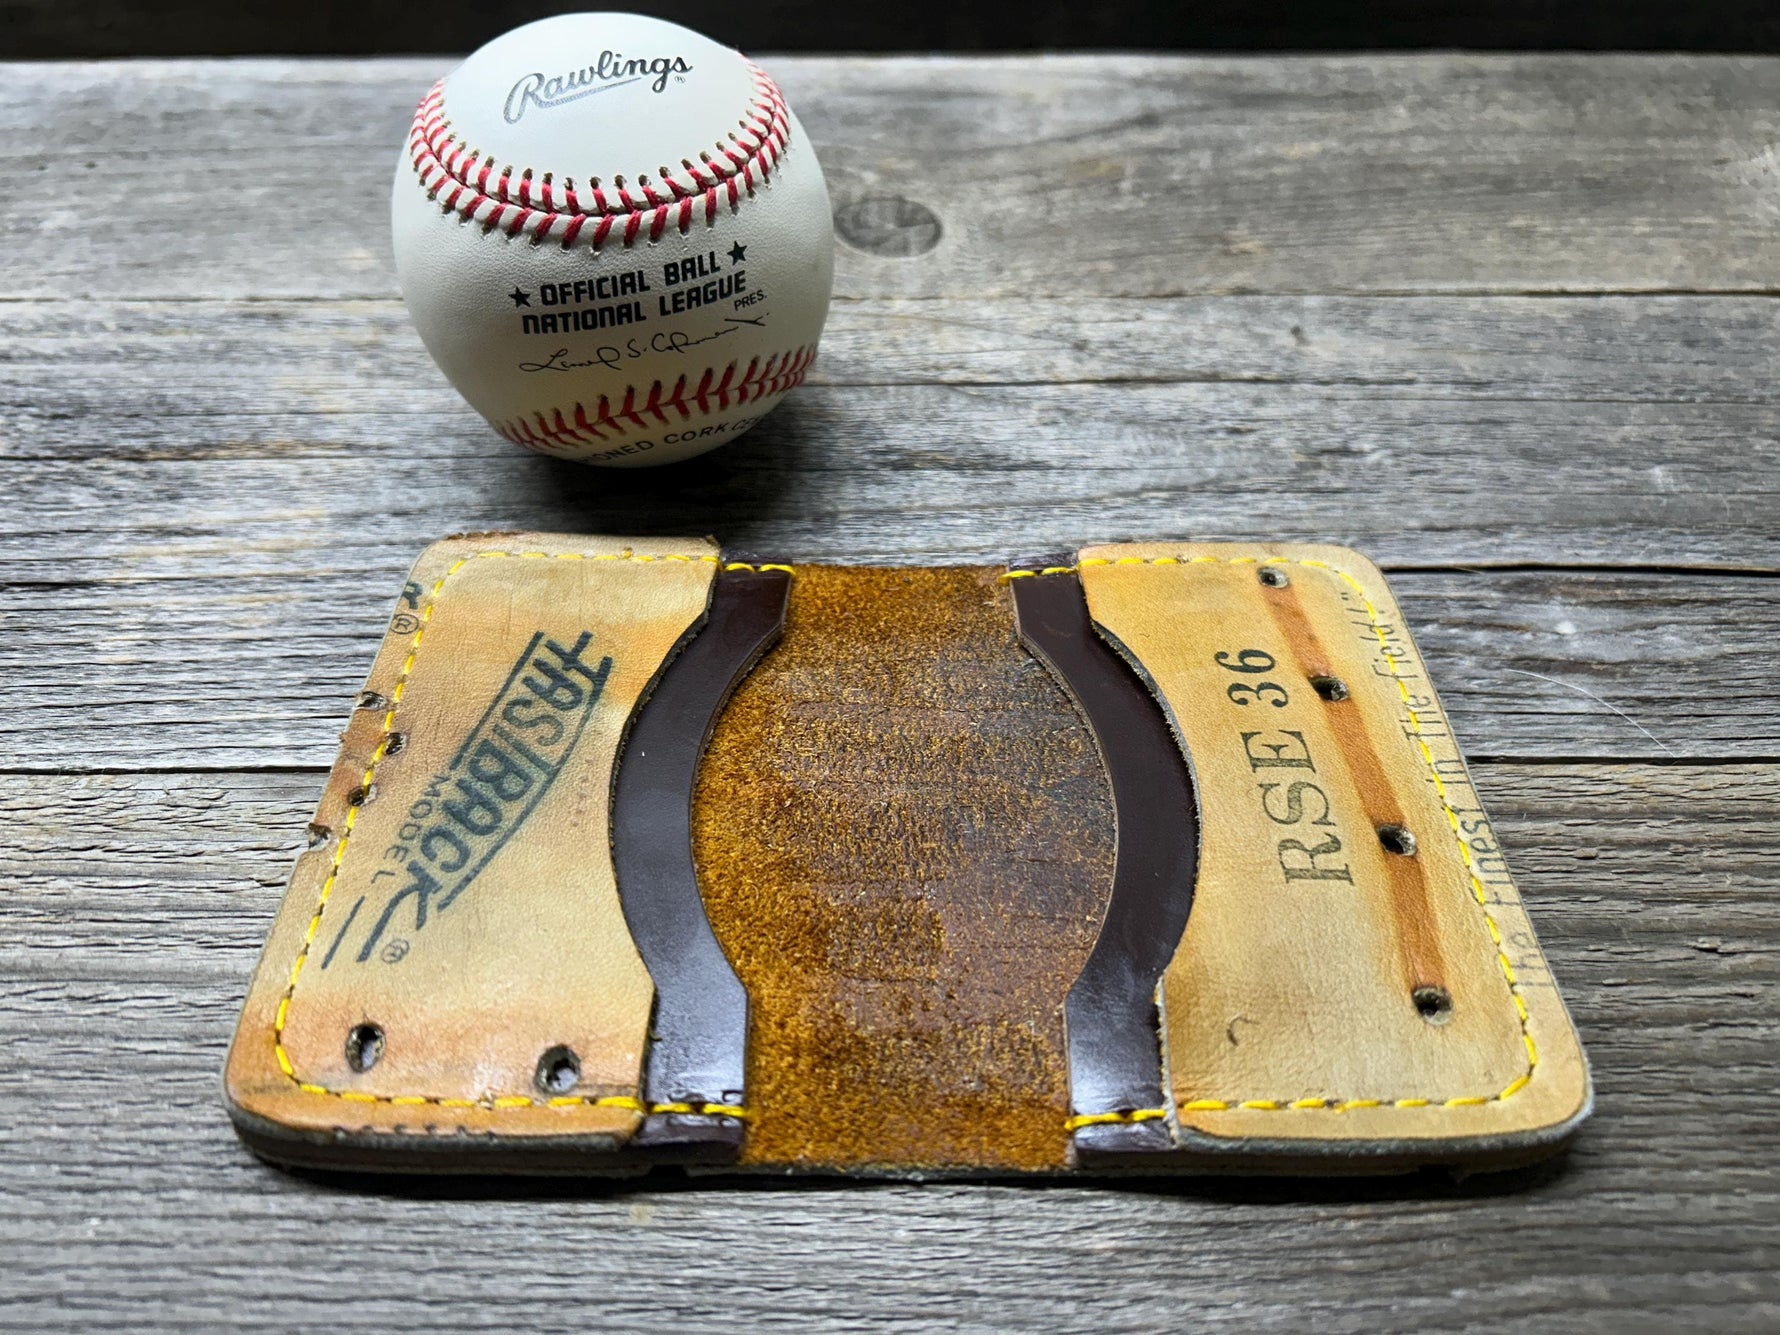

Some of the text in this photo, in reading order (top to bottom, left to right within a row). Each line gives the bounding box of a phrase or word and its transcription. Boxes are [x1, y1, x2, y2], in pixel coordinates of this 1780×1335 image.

[503, 50, 693, 124] Rawlings
[522, 270, 747, 334] NATIONAL LEAGUE
[540, 251, 720, 306] OFFICIAL BALL
[733, 290, 767, 311] PRES.
[664, 421, 727, 444] CORK
[1399, 694, 1447, 741] The
[1214, 649, 1355, 886] RSE 36
[371, 775, 448, 884] MODEL
